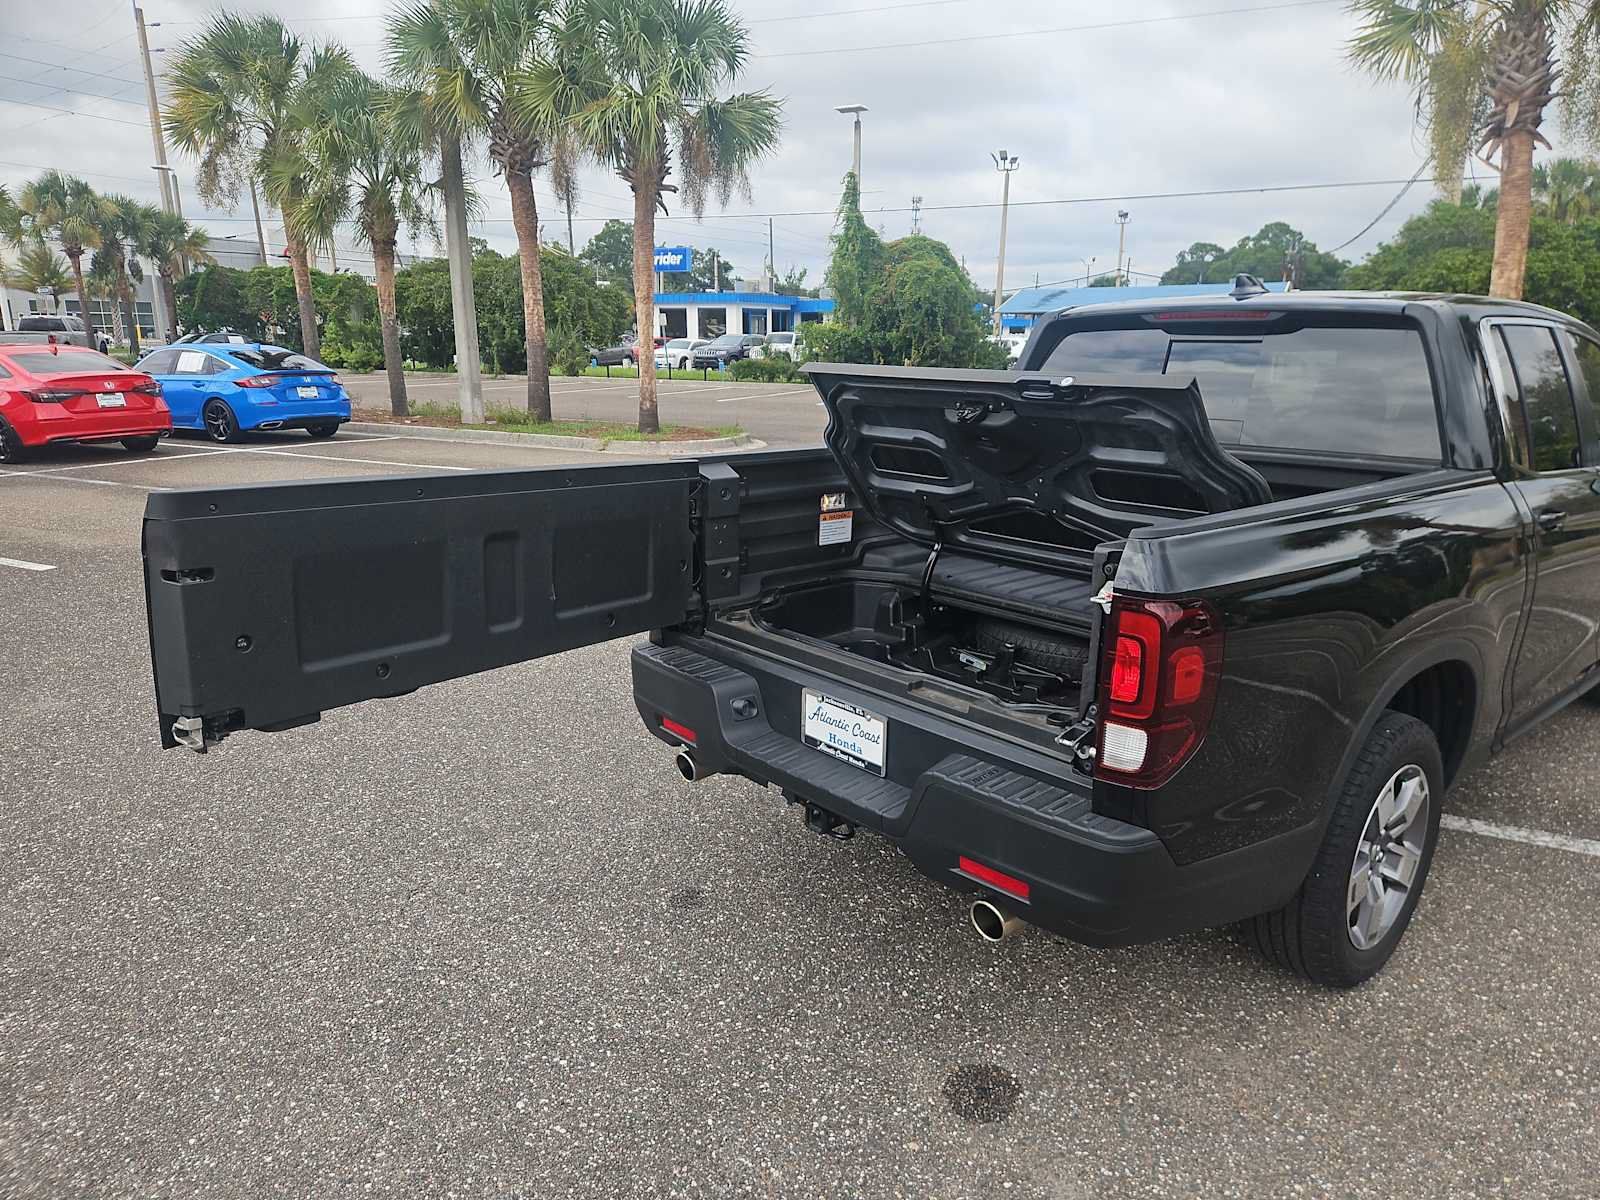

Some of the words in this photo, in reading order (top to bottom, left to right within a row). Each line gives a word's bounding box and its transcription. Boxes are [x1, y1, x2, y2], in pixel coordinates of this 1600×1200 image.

[808, 705, 850, 732] Atlantic
[852, 722, 881, 745] Coast
[829, 732, 863, 755] Honda
